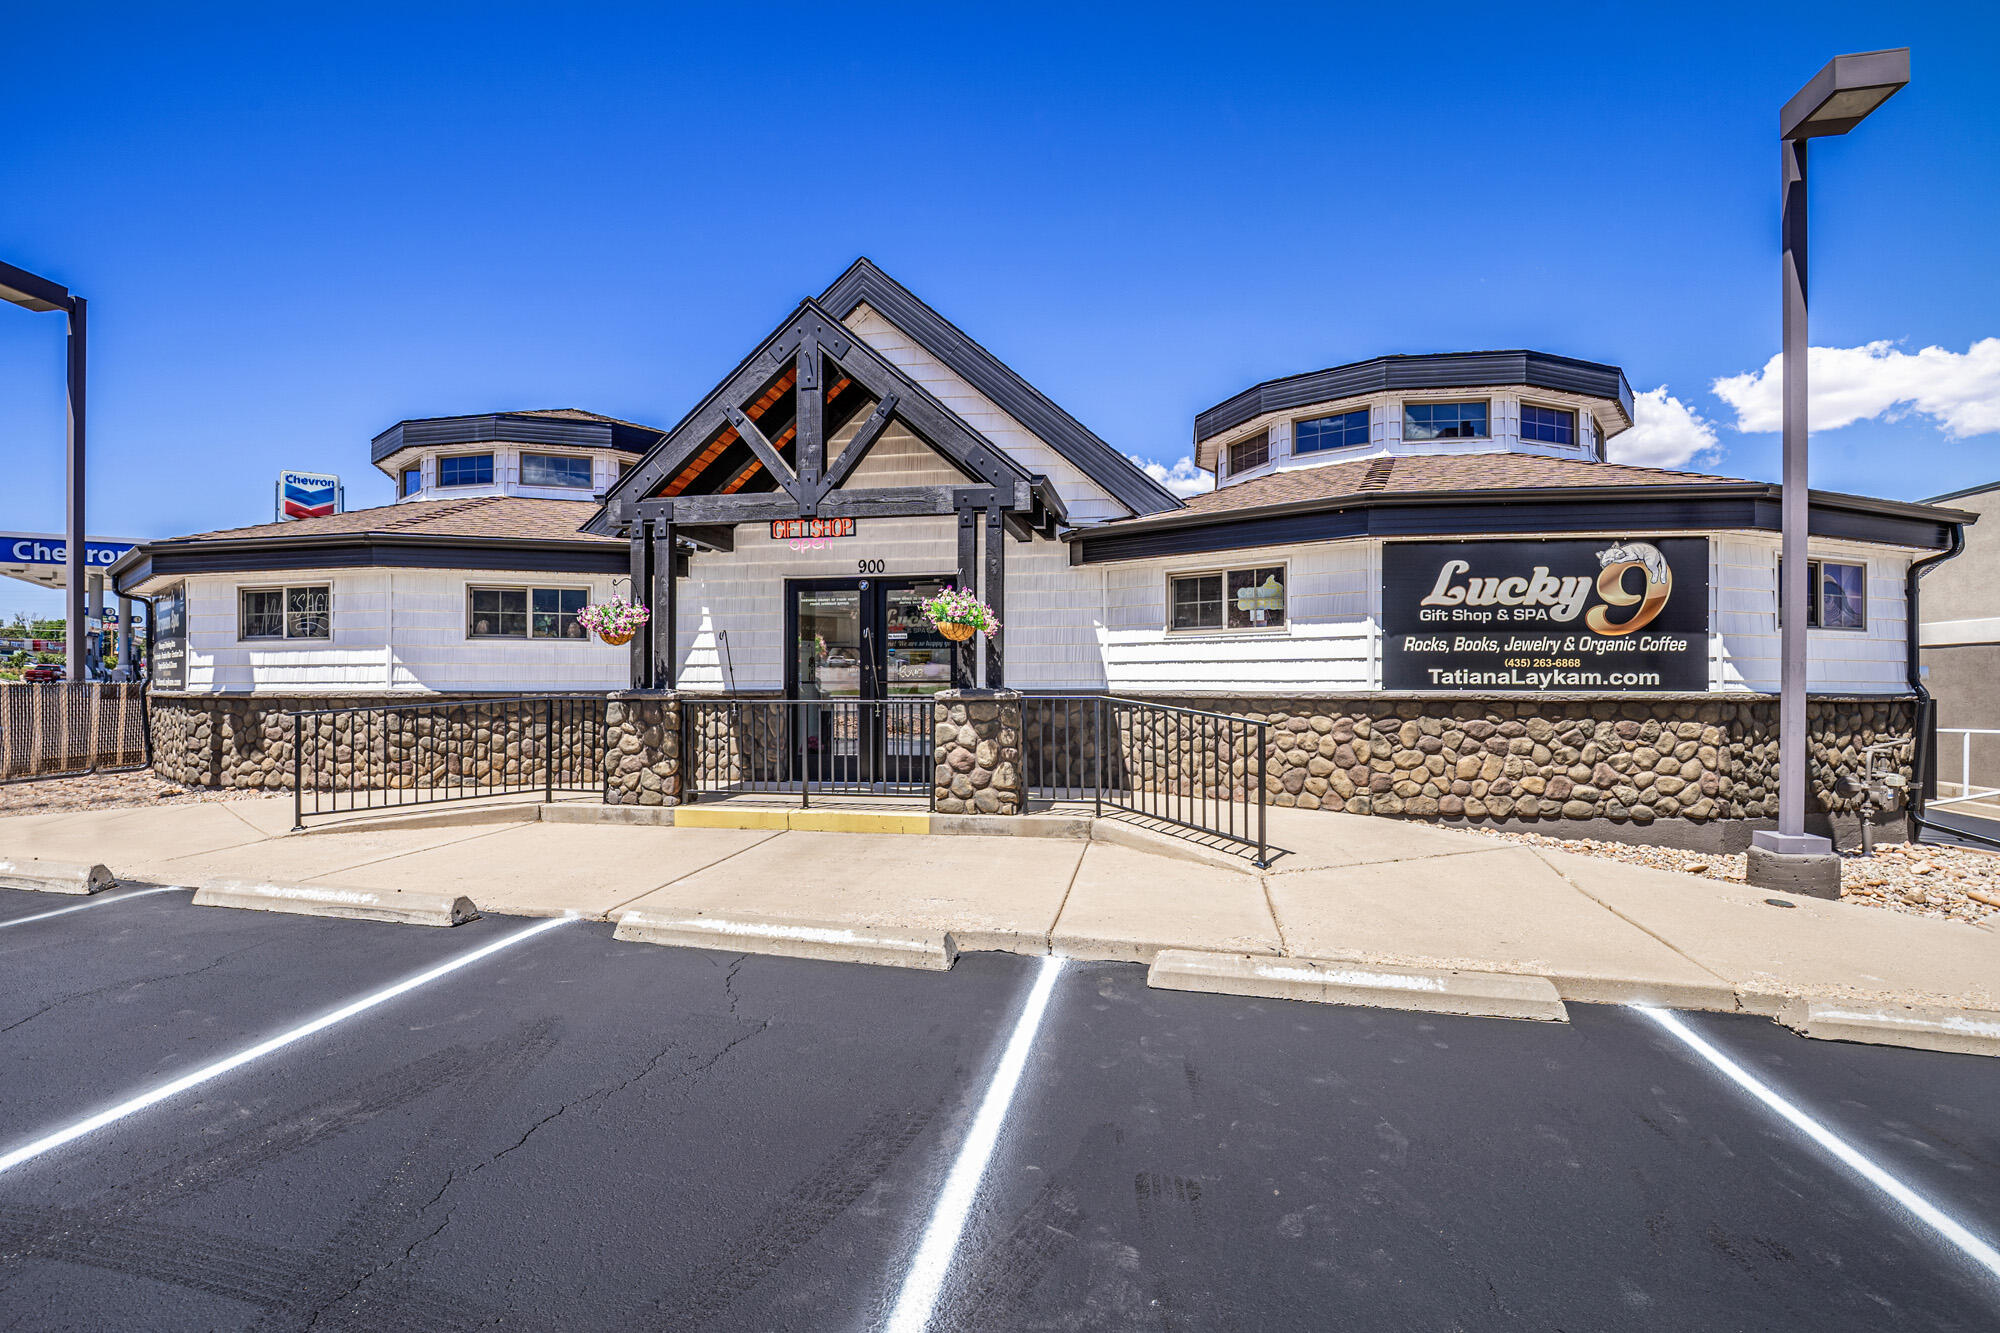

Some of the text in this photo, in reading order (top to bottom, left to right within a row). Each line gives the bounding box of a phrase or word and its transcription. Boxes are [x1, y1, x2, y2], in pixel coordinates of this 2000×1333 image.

[285, 474, 335, 487] Chevron
[772, 518, 853, 539] GIFT SHOP
[12, 541, 128, 564] Chero
[788, 537, 833, 554] open
[858, 559, 885, 574] 900
[1420, 557, 1673, 636] Lucky 9
[1420, 608, 1549, 624] Gift Shop & SPA
[1403, 636, 1688, 656] Rocks, Books, Jewelry & Organic Coffee
[1504, 658, 1581, 668] (435) 263-6868
[1428, 668, 1660, 688] TatianaLaykam.com
